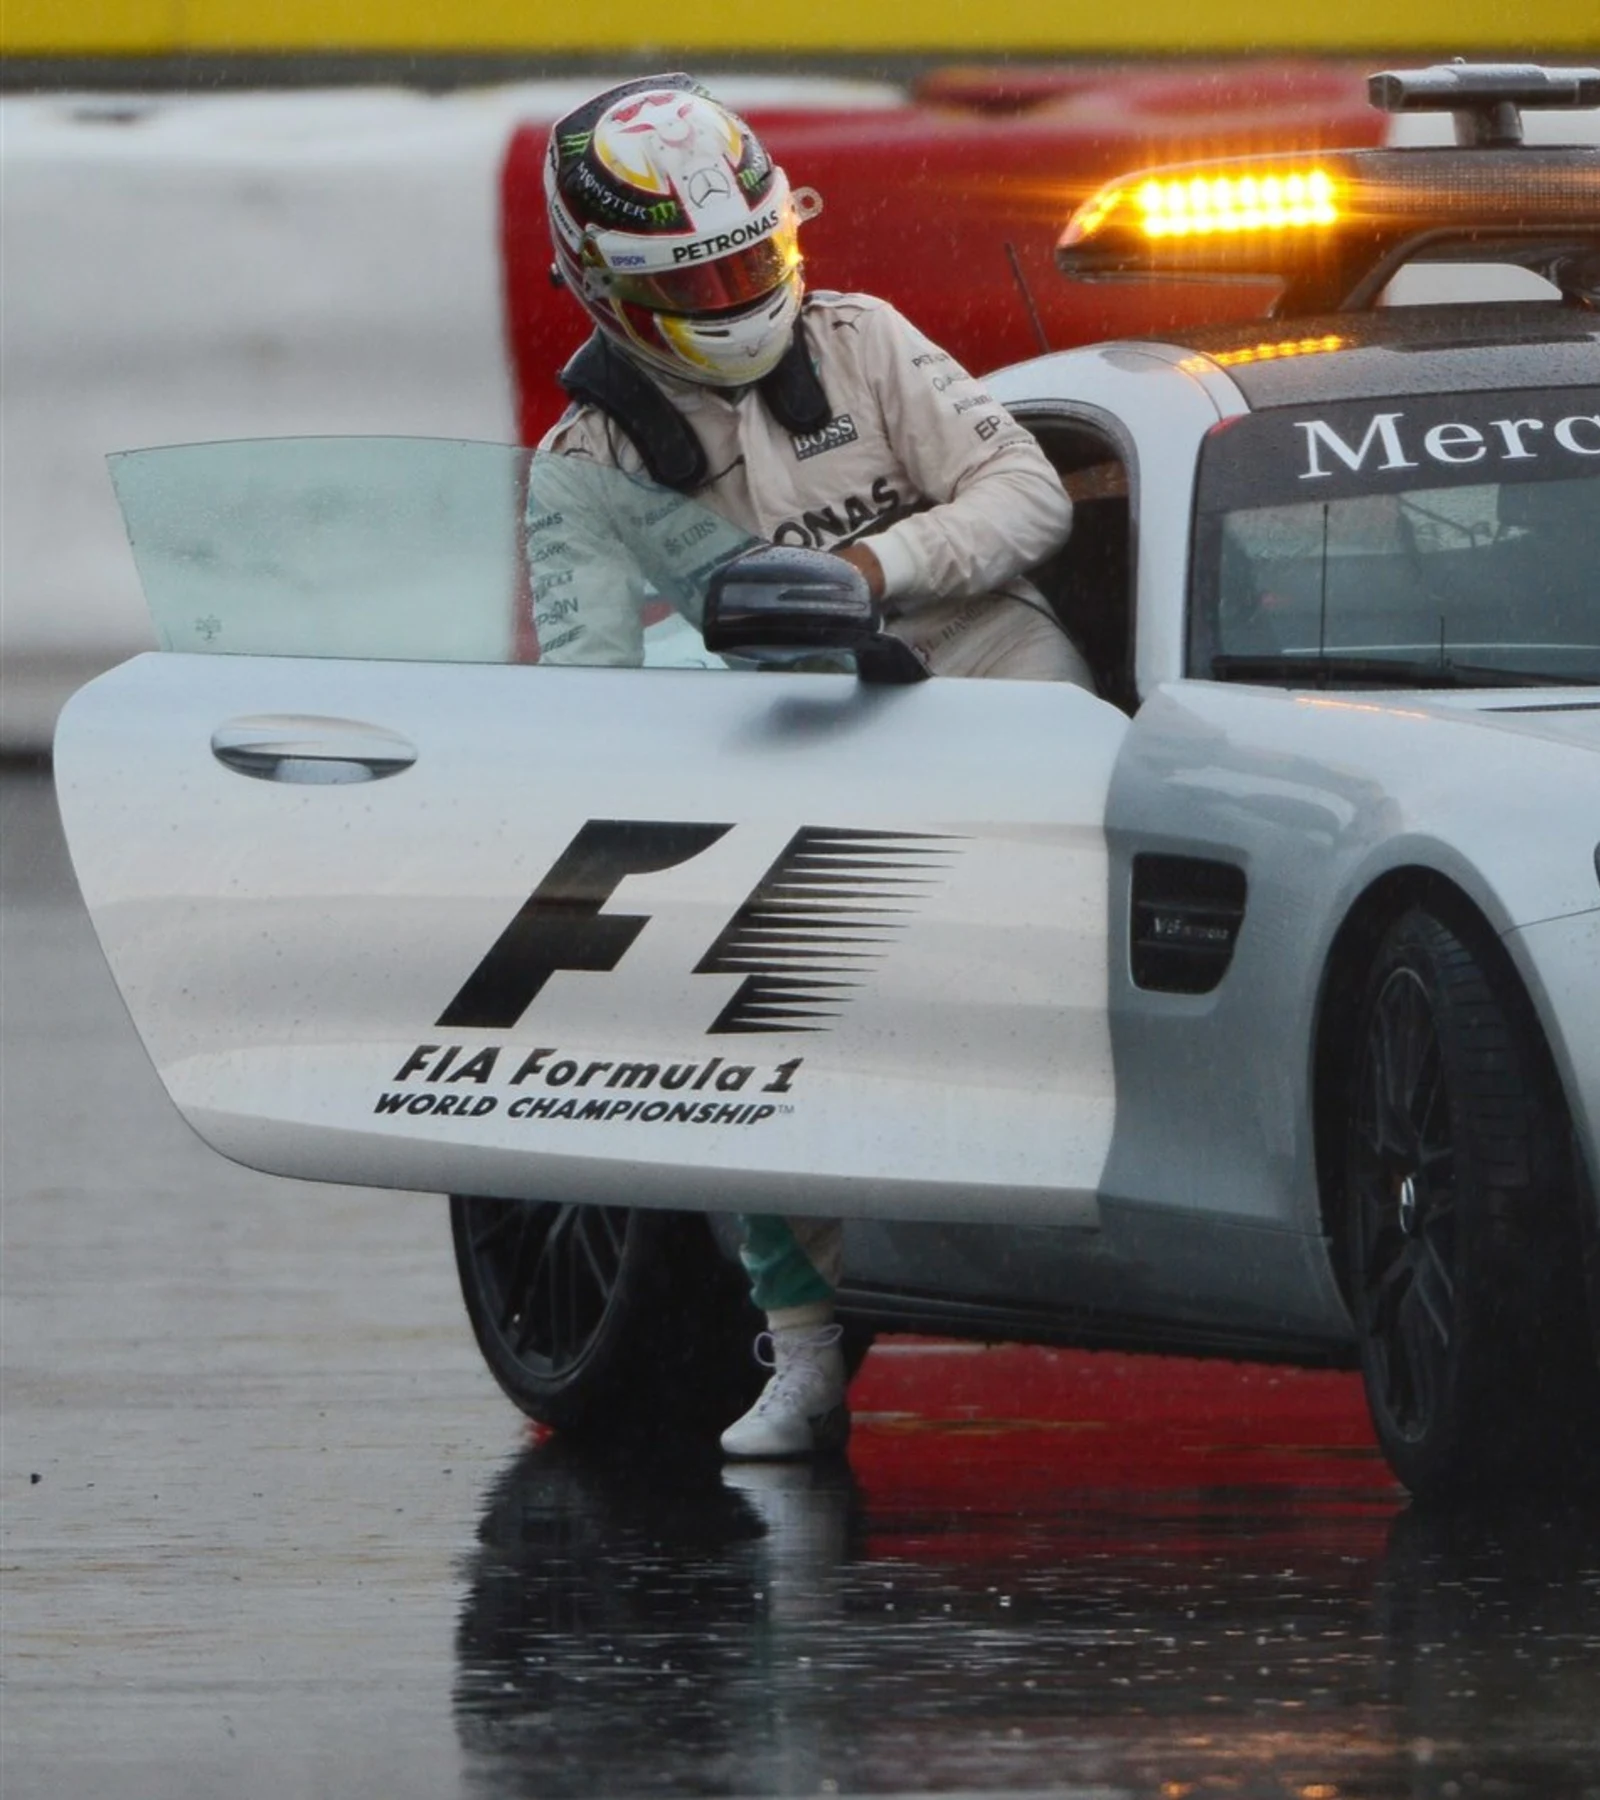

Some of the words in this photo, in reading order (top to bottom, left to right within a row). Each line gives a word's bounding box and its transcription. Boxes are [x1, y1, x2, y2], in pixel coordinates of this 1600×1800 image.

[577, 161, 647, 220] MONSTER
[611, 254, 647, 267] EPSON
[672, 210, 779, 263] PETRONAS
[793, 417, 854, 453] BOSS
[434, 819, 980, 1035] F1
[392, 1044, 502, 1084] FIA
[508, 1047, 757, 1092] Formula
[760, 1056, 805, 1093] 1
[372, 1092, 499, 1117] WORLD
